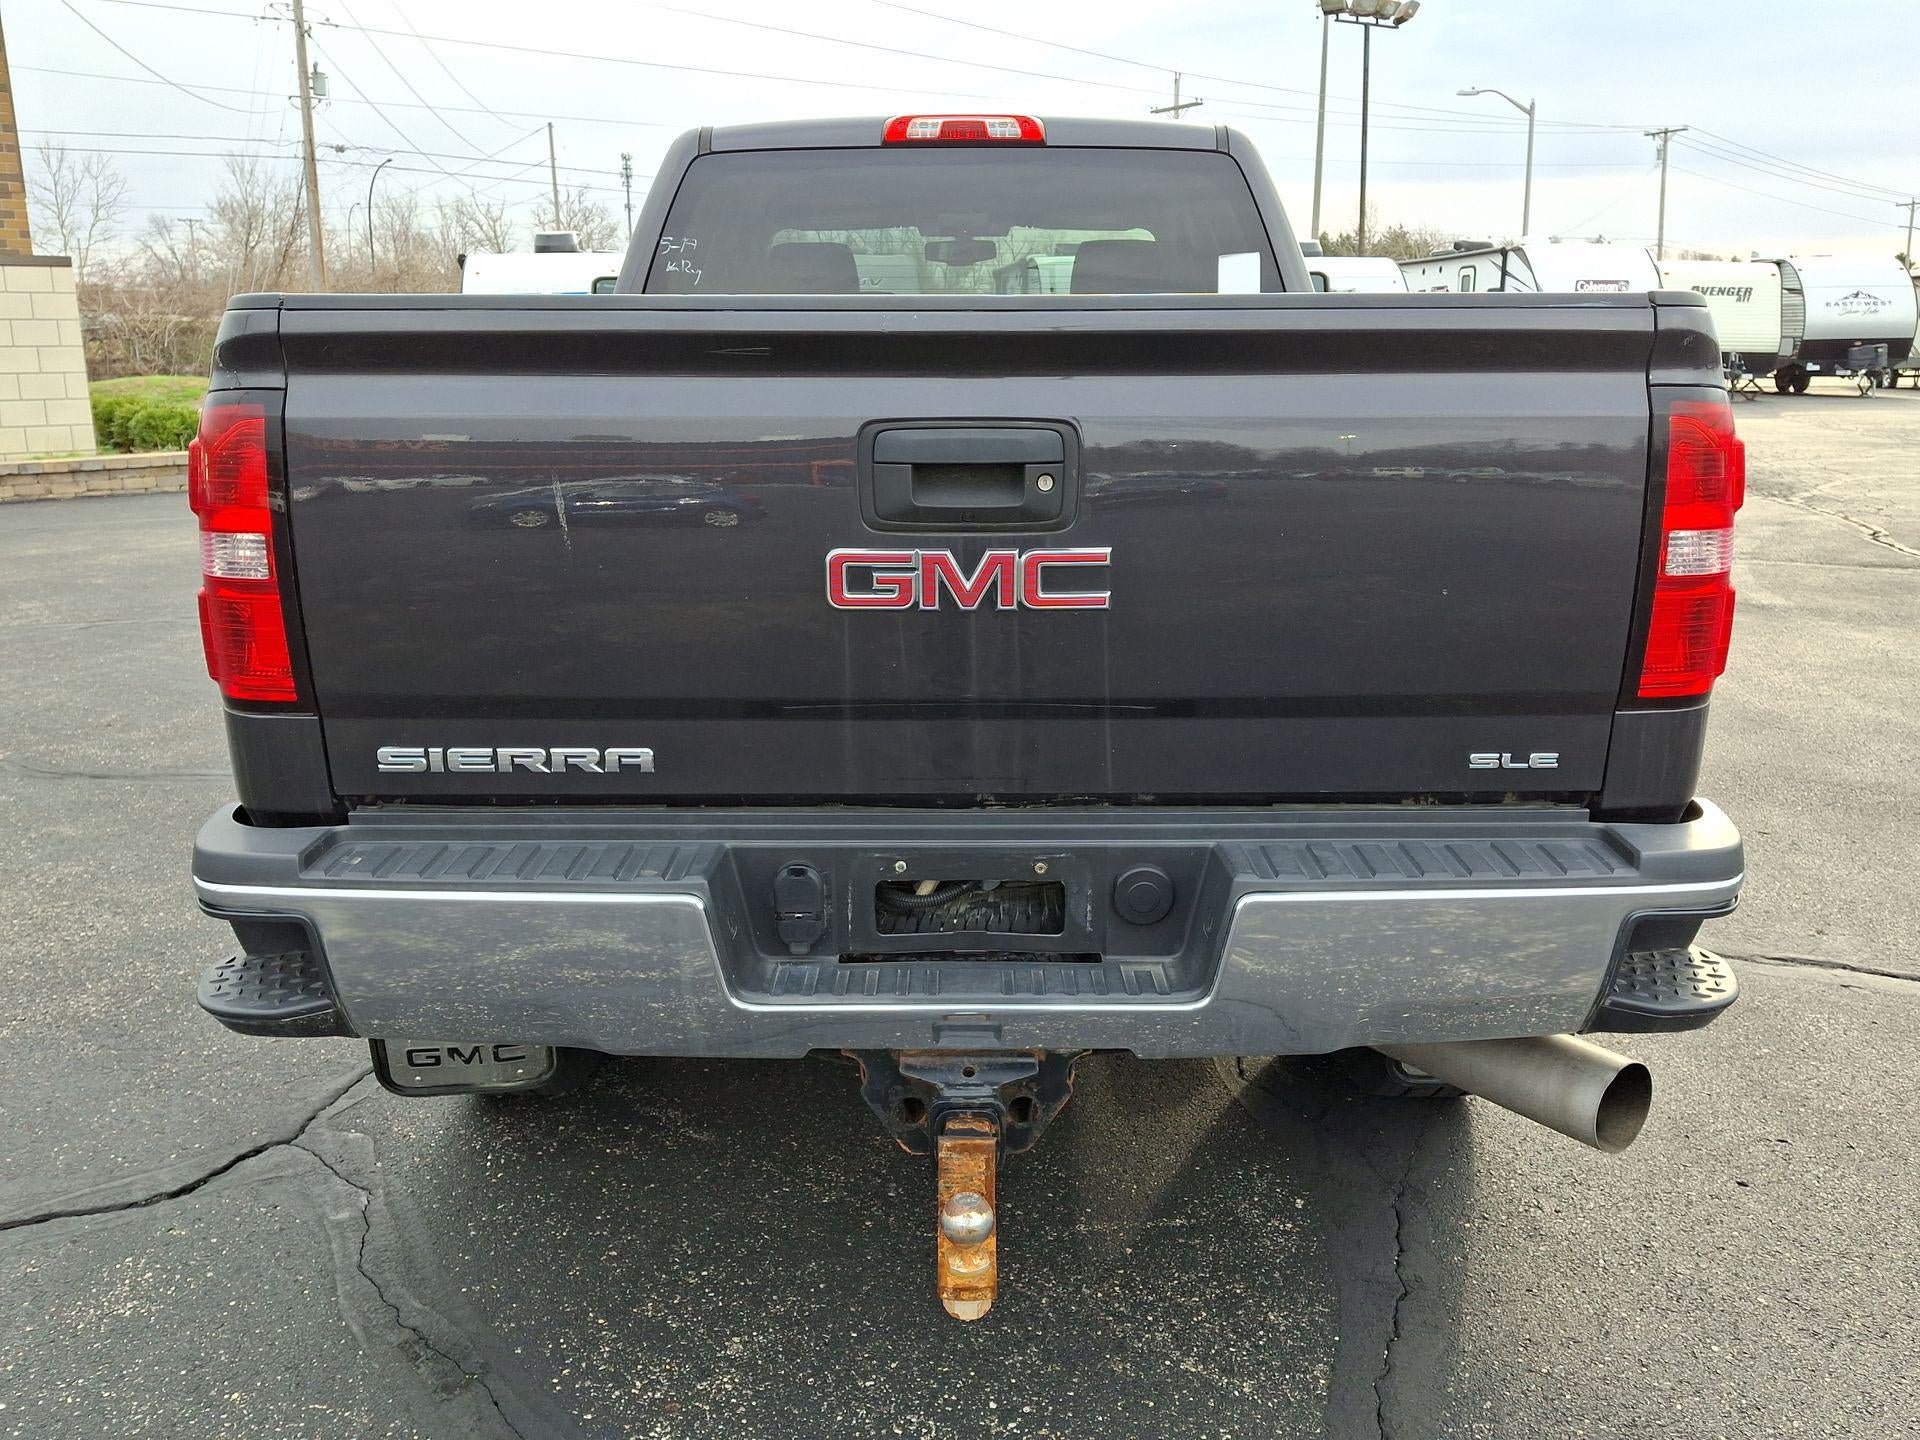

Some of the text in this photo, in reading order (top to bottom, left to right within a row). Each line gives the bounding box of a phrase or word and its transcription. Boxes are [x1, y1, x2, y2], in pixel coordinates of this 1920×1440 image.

[1576, 280, 1619, 292] Coleman
[826, 546, 1112, 612] GMC
[376, 746, 655, 774] SIERRA
[1468, 751, 1560, 770] SLE
[405, 1043, 528, 1069] GMC
